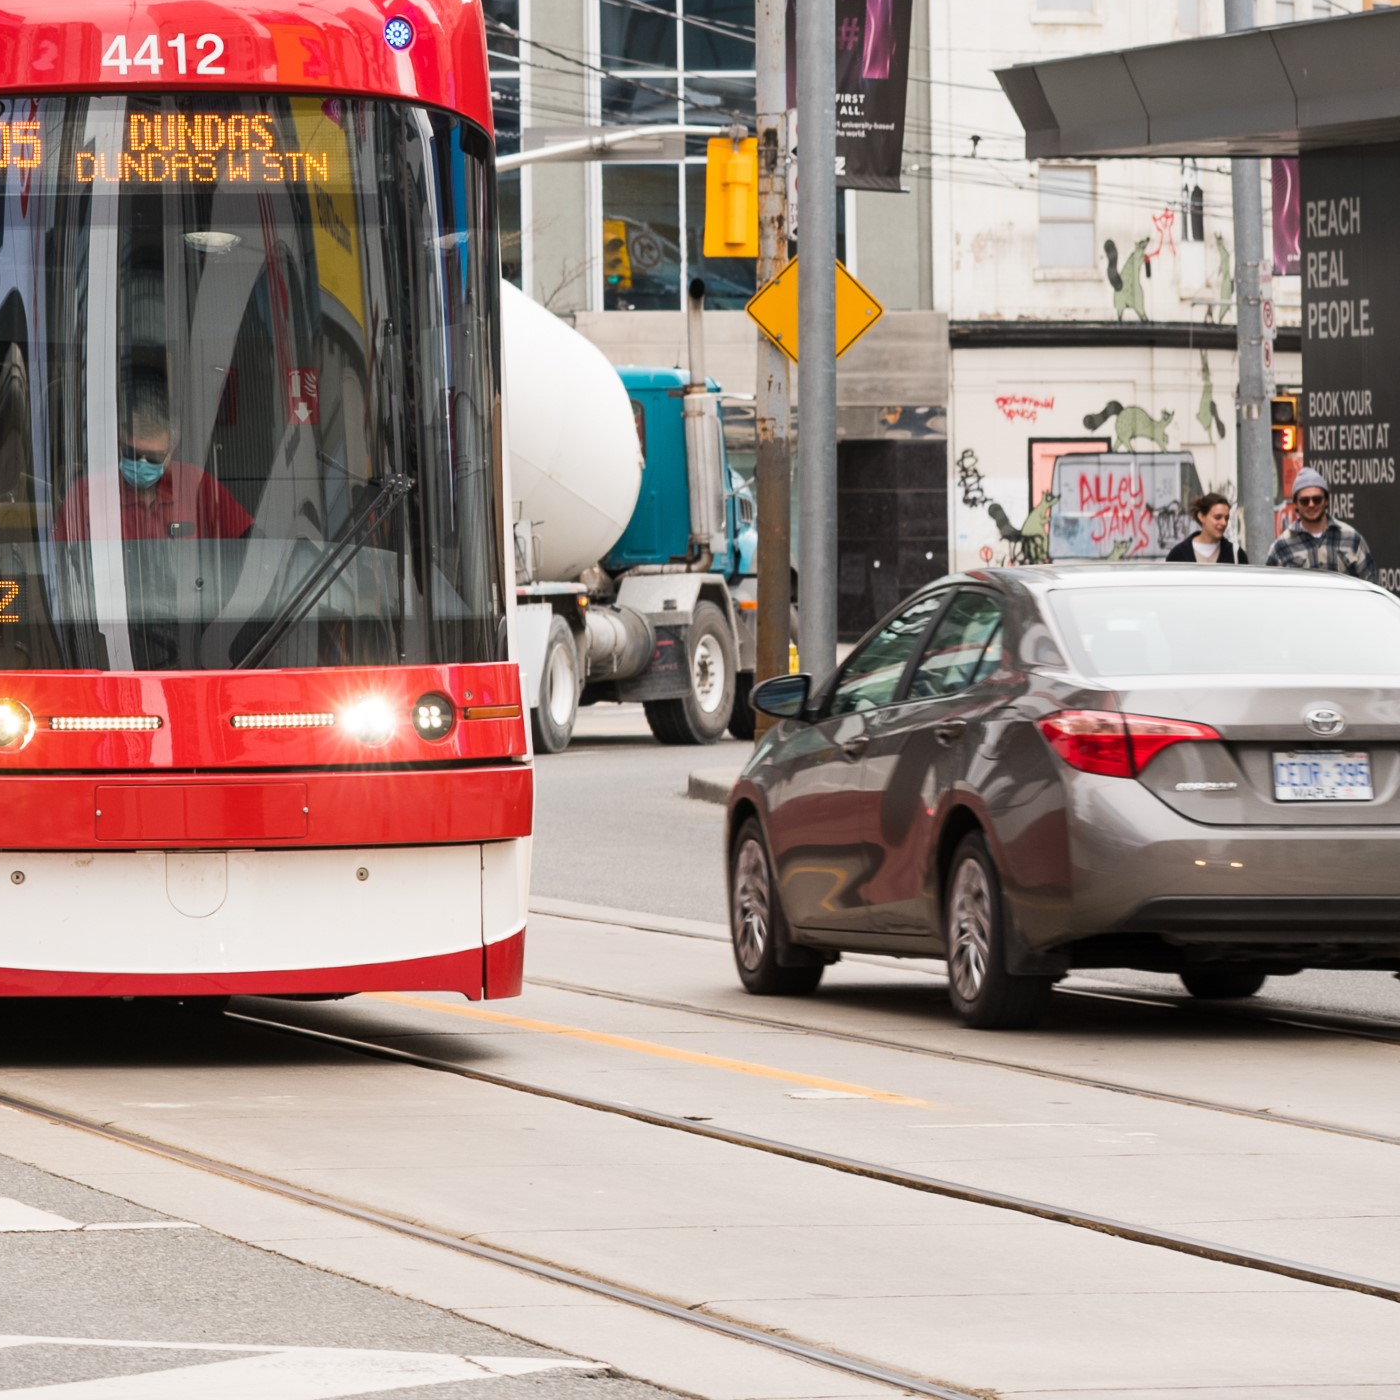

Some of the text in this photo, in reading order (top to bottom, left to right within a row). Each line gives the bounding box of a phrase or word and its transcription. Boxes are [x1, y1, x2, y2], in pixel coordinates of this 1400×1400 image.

[101, 33, 226, 75] 4412
[839, 105, 865, 116] ALL.
[130, 114, 273, 151] DUNDAS
[77, 152, 328, 182] DUNDAS W STN
[1306, 197, 1360, 238] REACH
[1307, 249, 1349, 289] REAL
[1308, 299, 1374, 340] PEOPLE.
[1309, 389, 1372, 418] BOOK YOUR
[1309, 423, 1390, 451] NEXT EVENT AT
